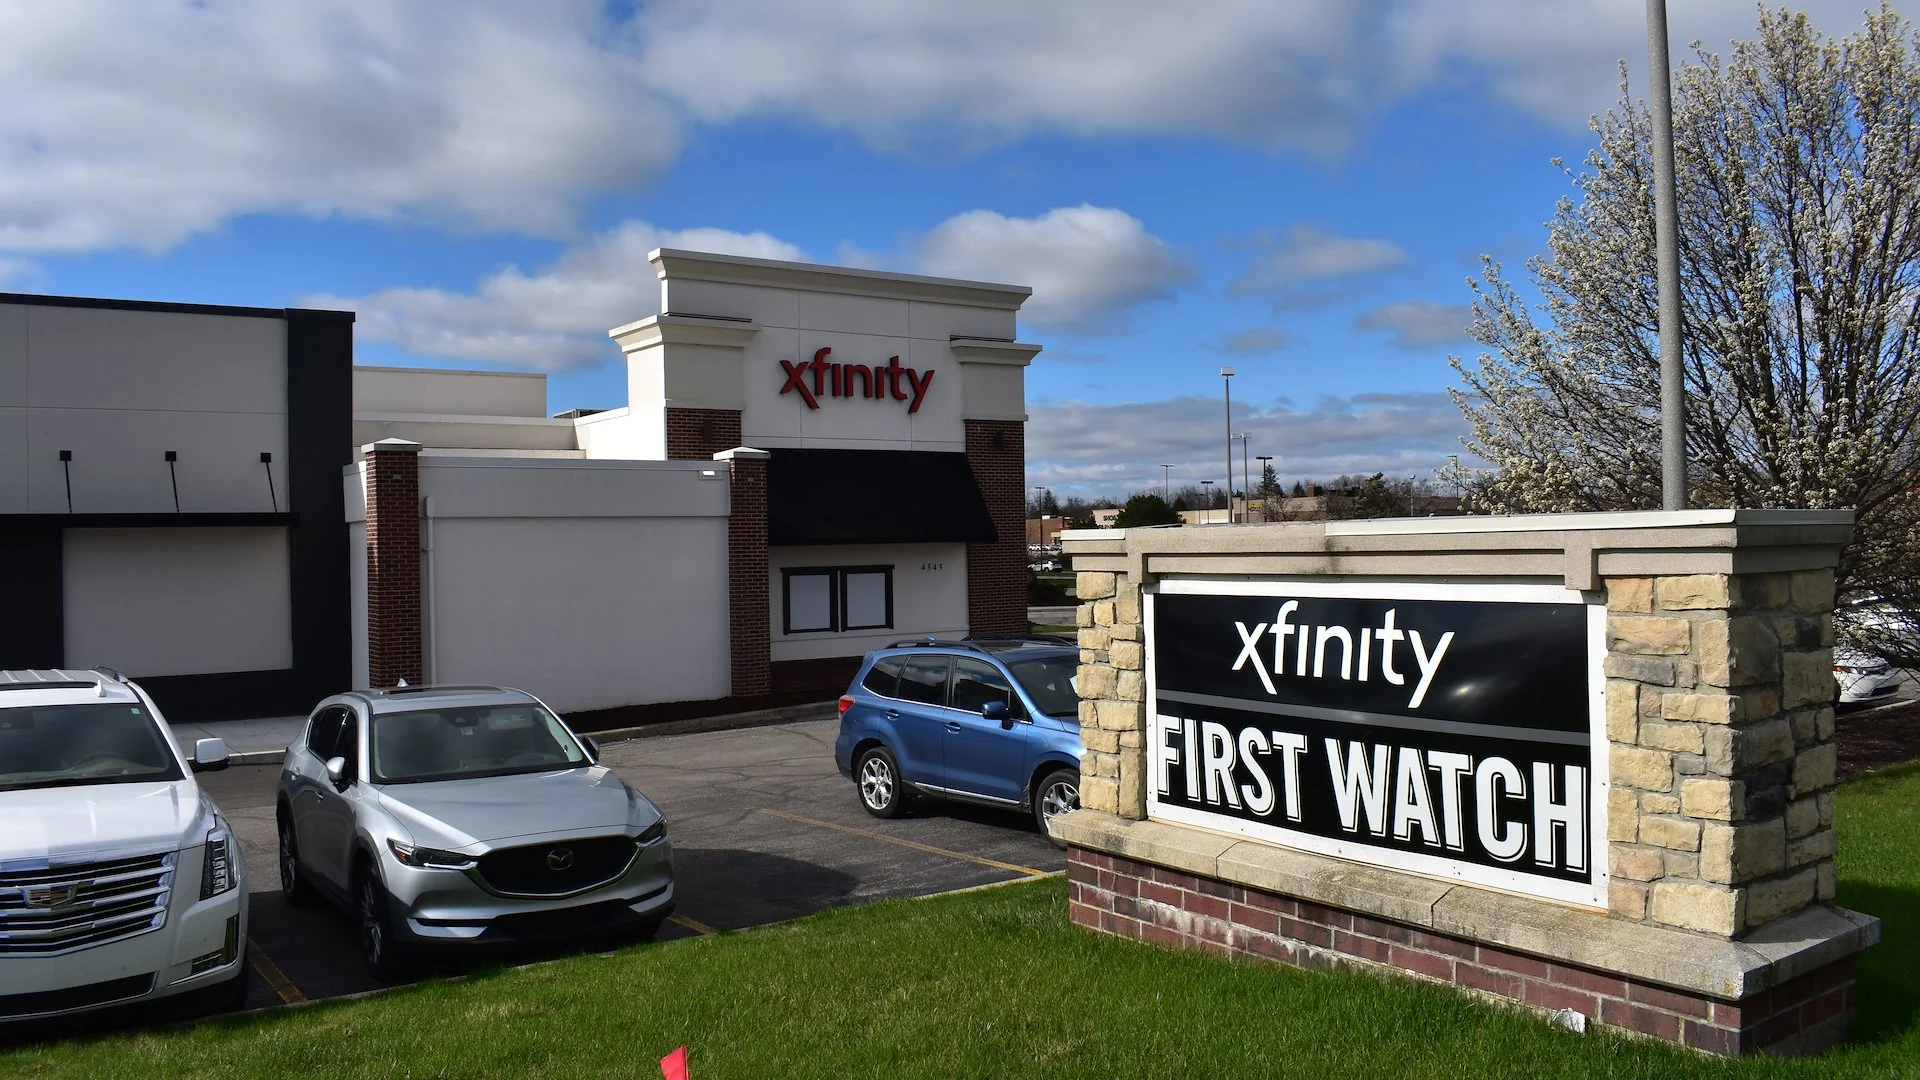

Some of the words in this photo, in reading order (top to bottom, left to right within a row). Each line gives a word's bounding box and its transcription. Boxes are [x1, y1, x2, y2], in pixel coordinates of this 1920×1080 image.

[779, 346, 935, 414] xfinity
[920, 563, 943, 571] 4545
[1232, 600, 1455, 708] xfinity
[1157, 714, 1308, 822] FIRST
[1324, 737, 1587, 873] WATCH
